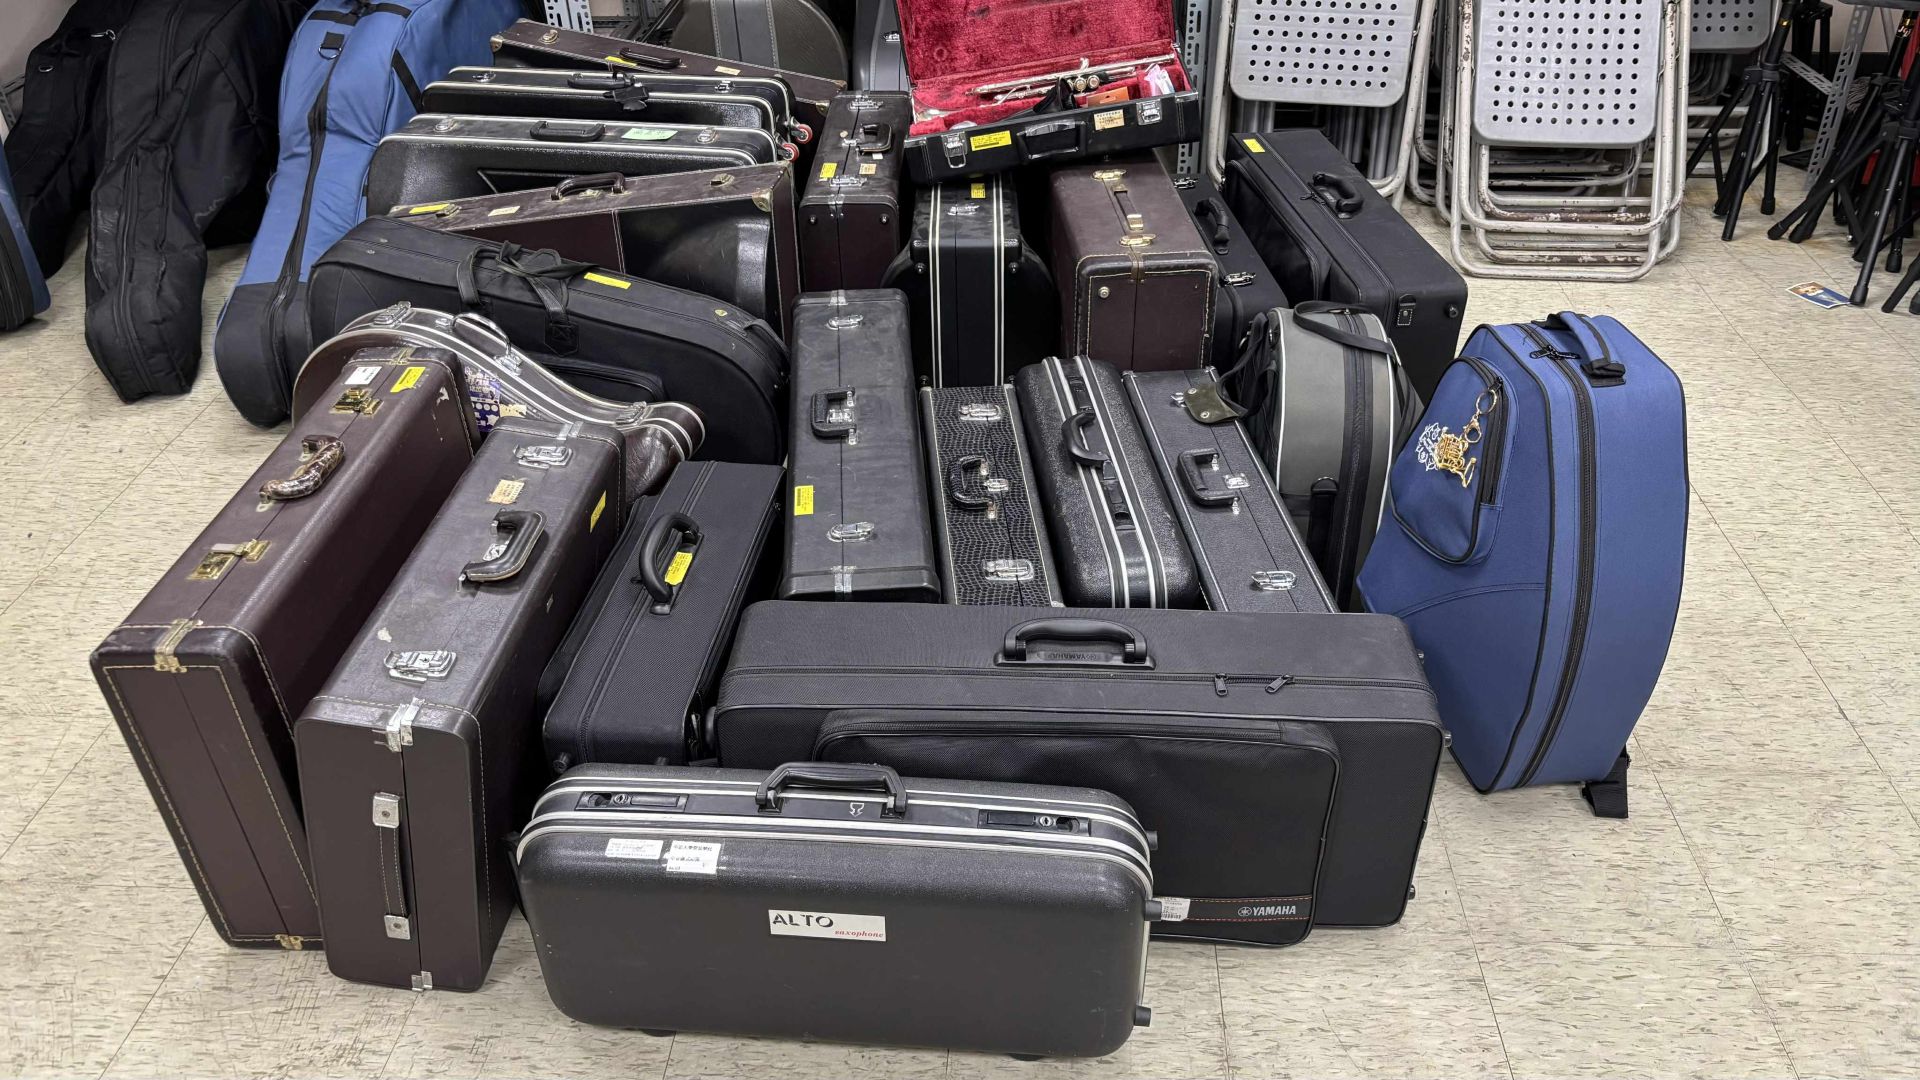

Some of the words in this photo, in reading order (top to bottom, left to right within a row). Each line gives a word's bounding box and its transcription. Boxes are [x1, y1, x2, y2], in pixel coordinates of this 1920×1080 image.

[1252, 905, 1297, 916] YAMAHA
[772, 912, 834, 928] ALTO
[834, 930, 884, 938] saxophone
